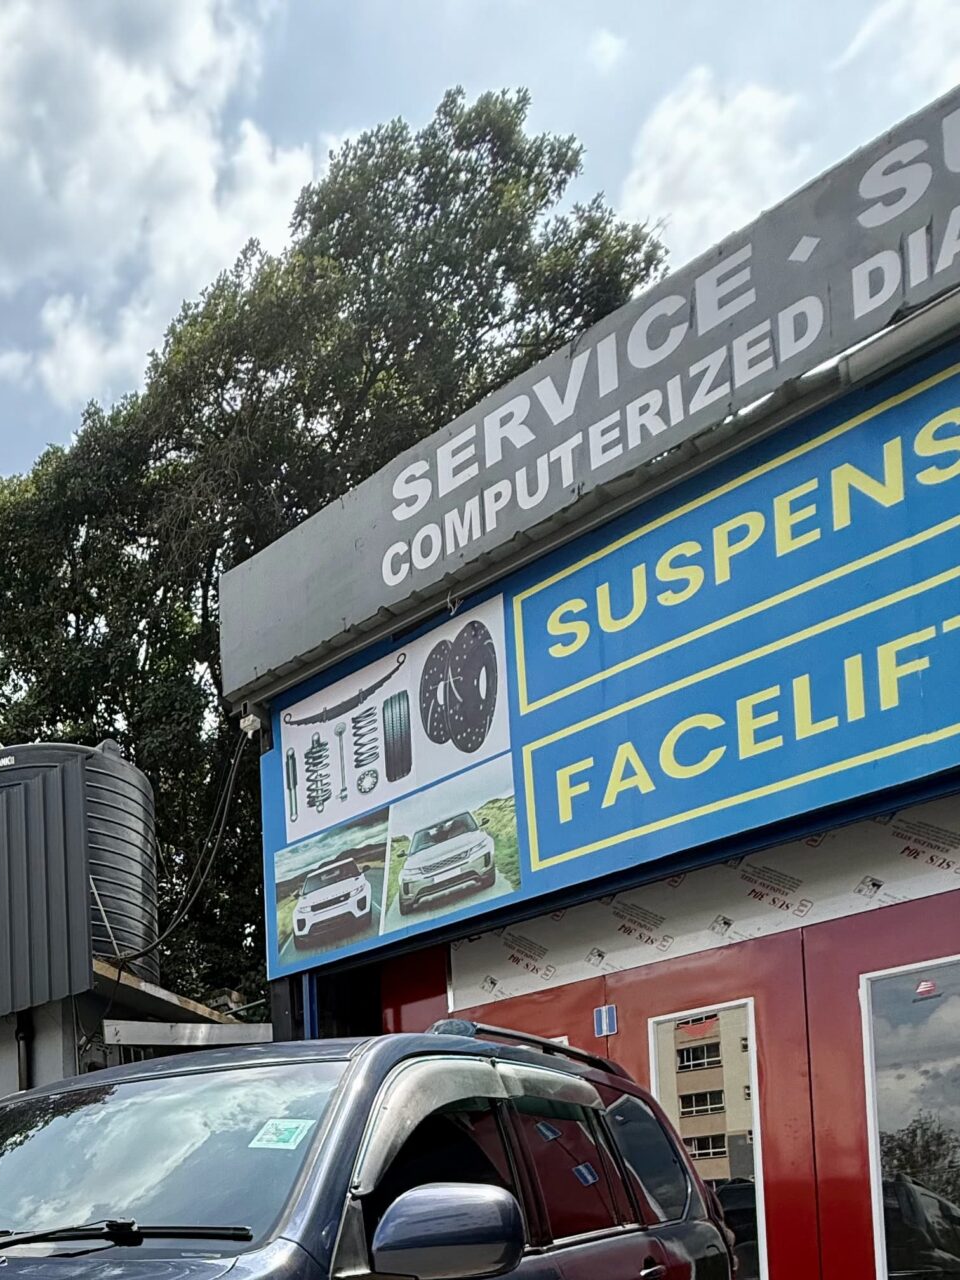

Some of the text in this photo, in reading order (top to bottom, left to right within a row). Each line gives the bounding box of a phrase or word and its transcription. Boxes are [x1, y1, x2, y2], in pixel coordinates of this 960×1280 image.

[381, 294, 824, 586] COMPUTERIZED
[392, 109, 960, 522] SERVICE S
[546, 407, 960, 659] SUSPENS
